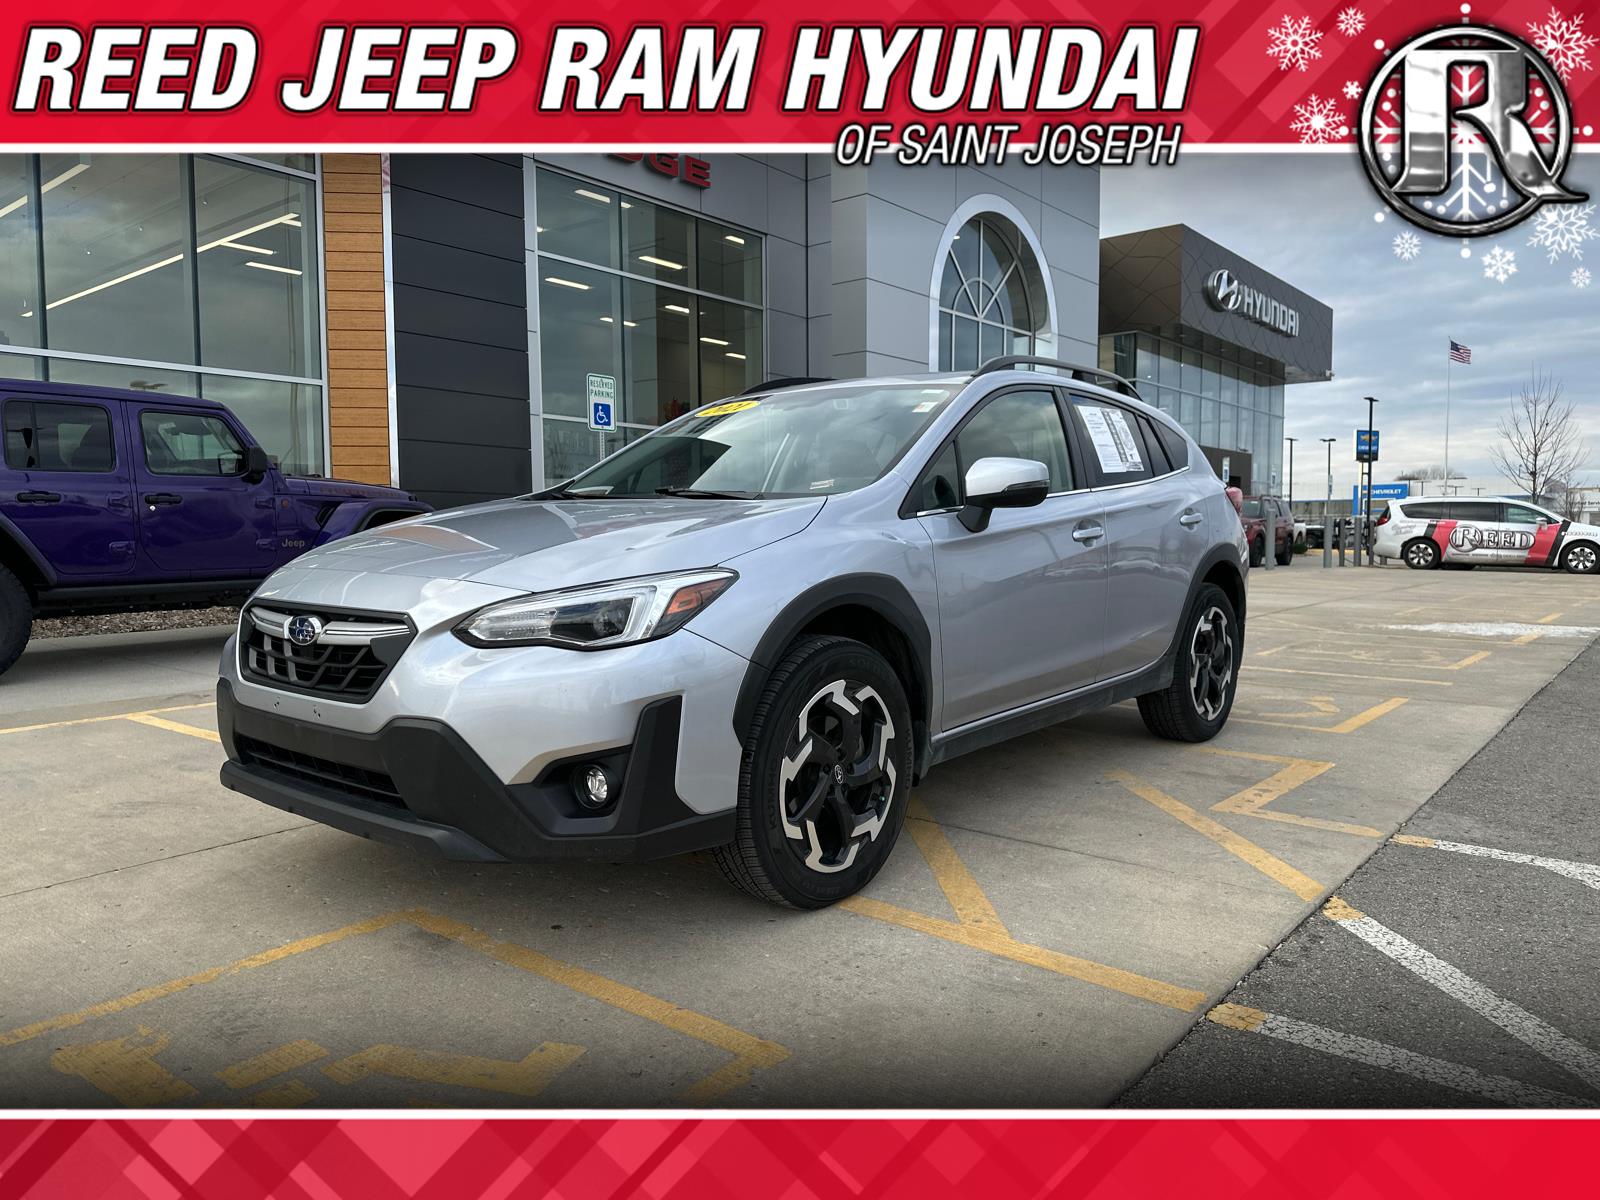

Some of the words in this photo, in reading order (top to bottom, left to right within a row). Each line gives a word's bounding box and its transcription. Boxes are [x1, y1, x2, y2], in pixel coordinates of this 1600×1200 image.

[1243, 285, 1299, 337] HYUNDAI
[590, 389, 613, 399] PARKING
[281, 537, 305, 549] Jeep
[1450, 525, 1535, 552] REED
